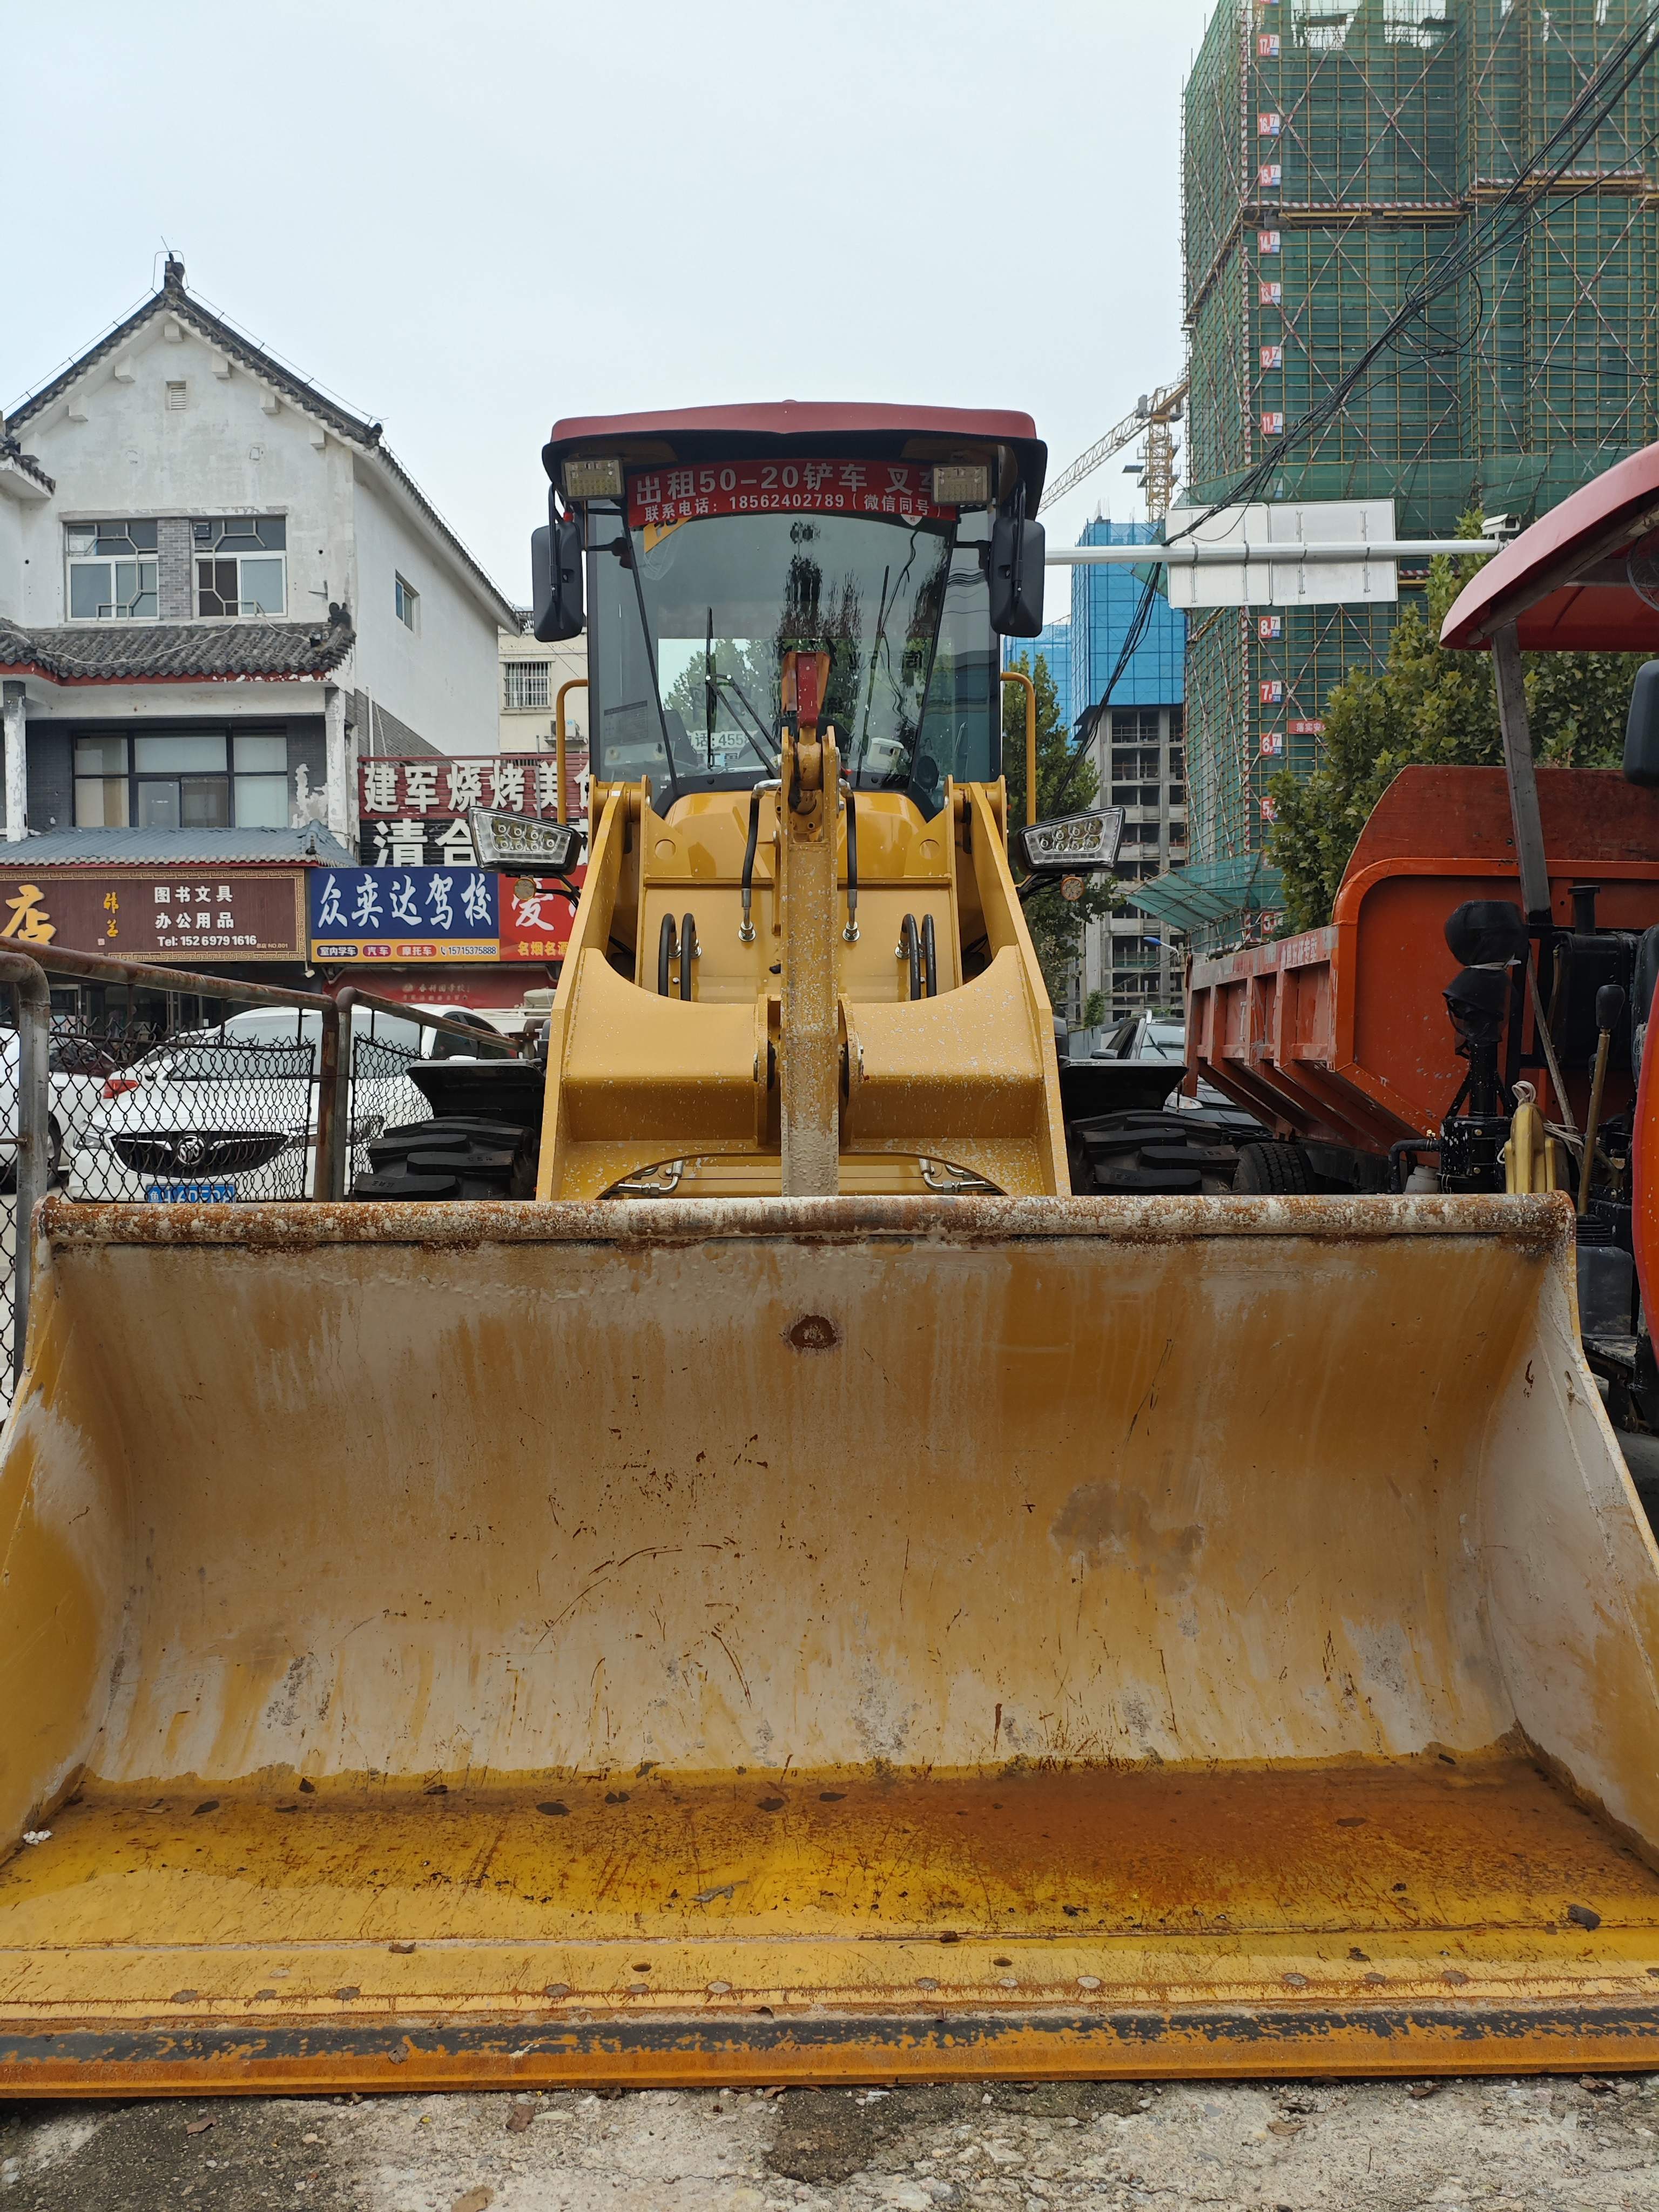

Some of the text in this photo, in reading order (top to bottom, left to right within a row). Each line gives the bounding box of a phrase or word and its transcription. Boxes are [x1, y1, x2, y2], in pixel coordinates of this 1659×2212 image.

[636, 463, 867, 505] 出租50-20铲车
[730, 494, 844, 509] 18562402789
[1261, 619, 1271, 636] 8F
[1261, 684, 1273, 700] 7F
[154, 886, 233, 903] 图书文具
[318, 873, 492, 930] 众奕达驾校
[155, 912, 234, 929] 办公用品
[320, 946, 496, 956] 室内学车 汽车 摩托车 15715375888
